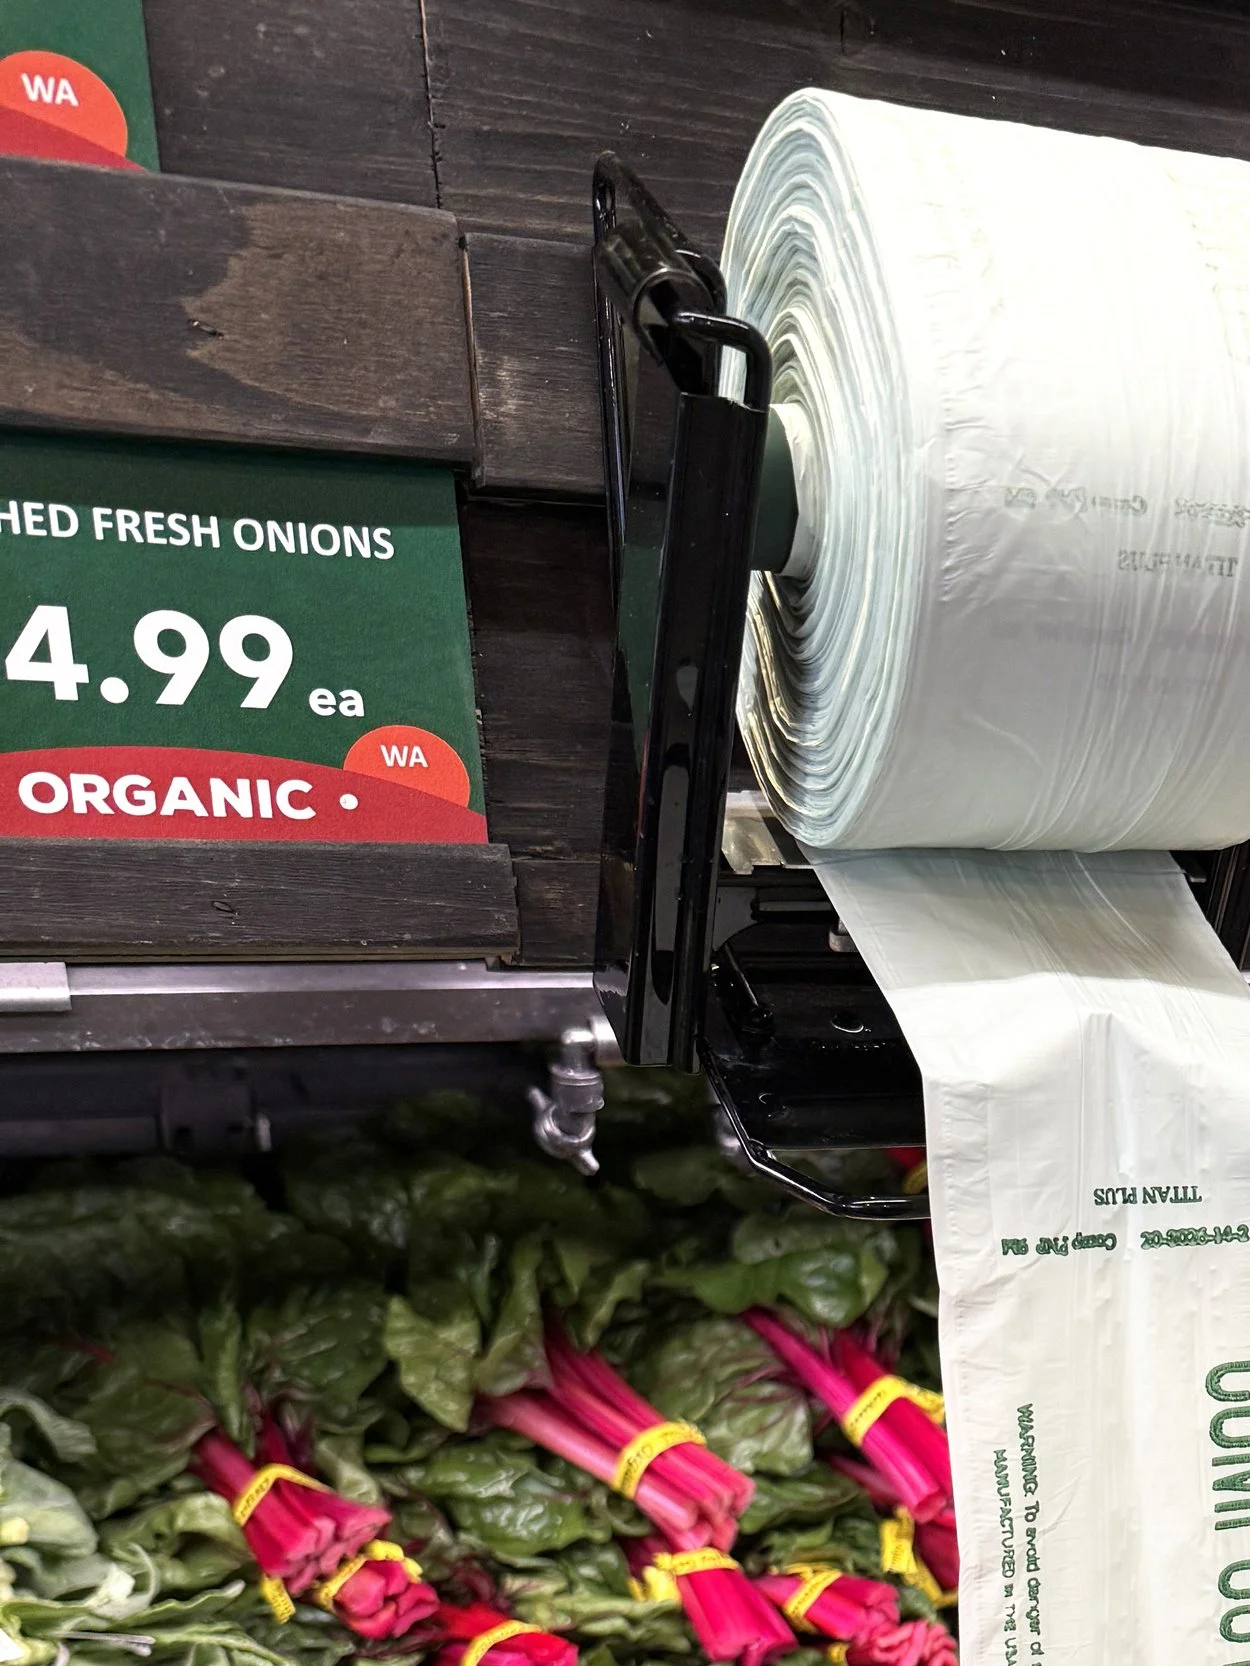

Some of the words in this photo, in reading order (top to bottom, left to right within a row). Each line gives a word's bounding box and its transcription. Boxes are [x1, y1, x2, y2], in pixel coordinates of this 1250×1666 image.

[22, 72, 78, 107] WA
[93, 508, 220, 548] FRESH
[233, 519, 394, 561] ONIONS
[5, 605, 293, 710] 4.99
[309, 686, 365, 717] ea
[380, 744, 428, 769] WA
[18, 771, 316, 821] ORGANIC
[1093, 1187, 1138, 1206] PLUS
[1142, 1186, 1202, 1204] TITAN
[1024, 1500, 1040, 1523] To
